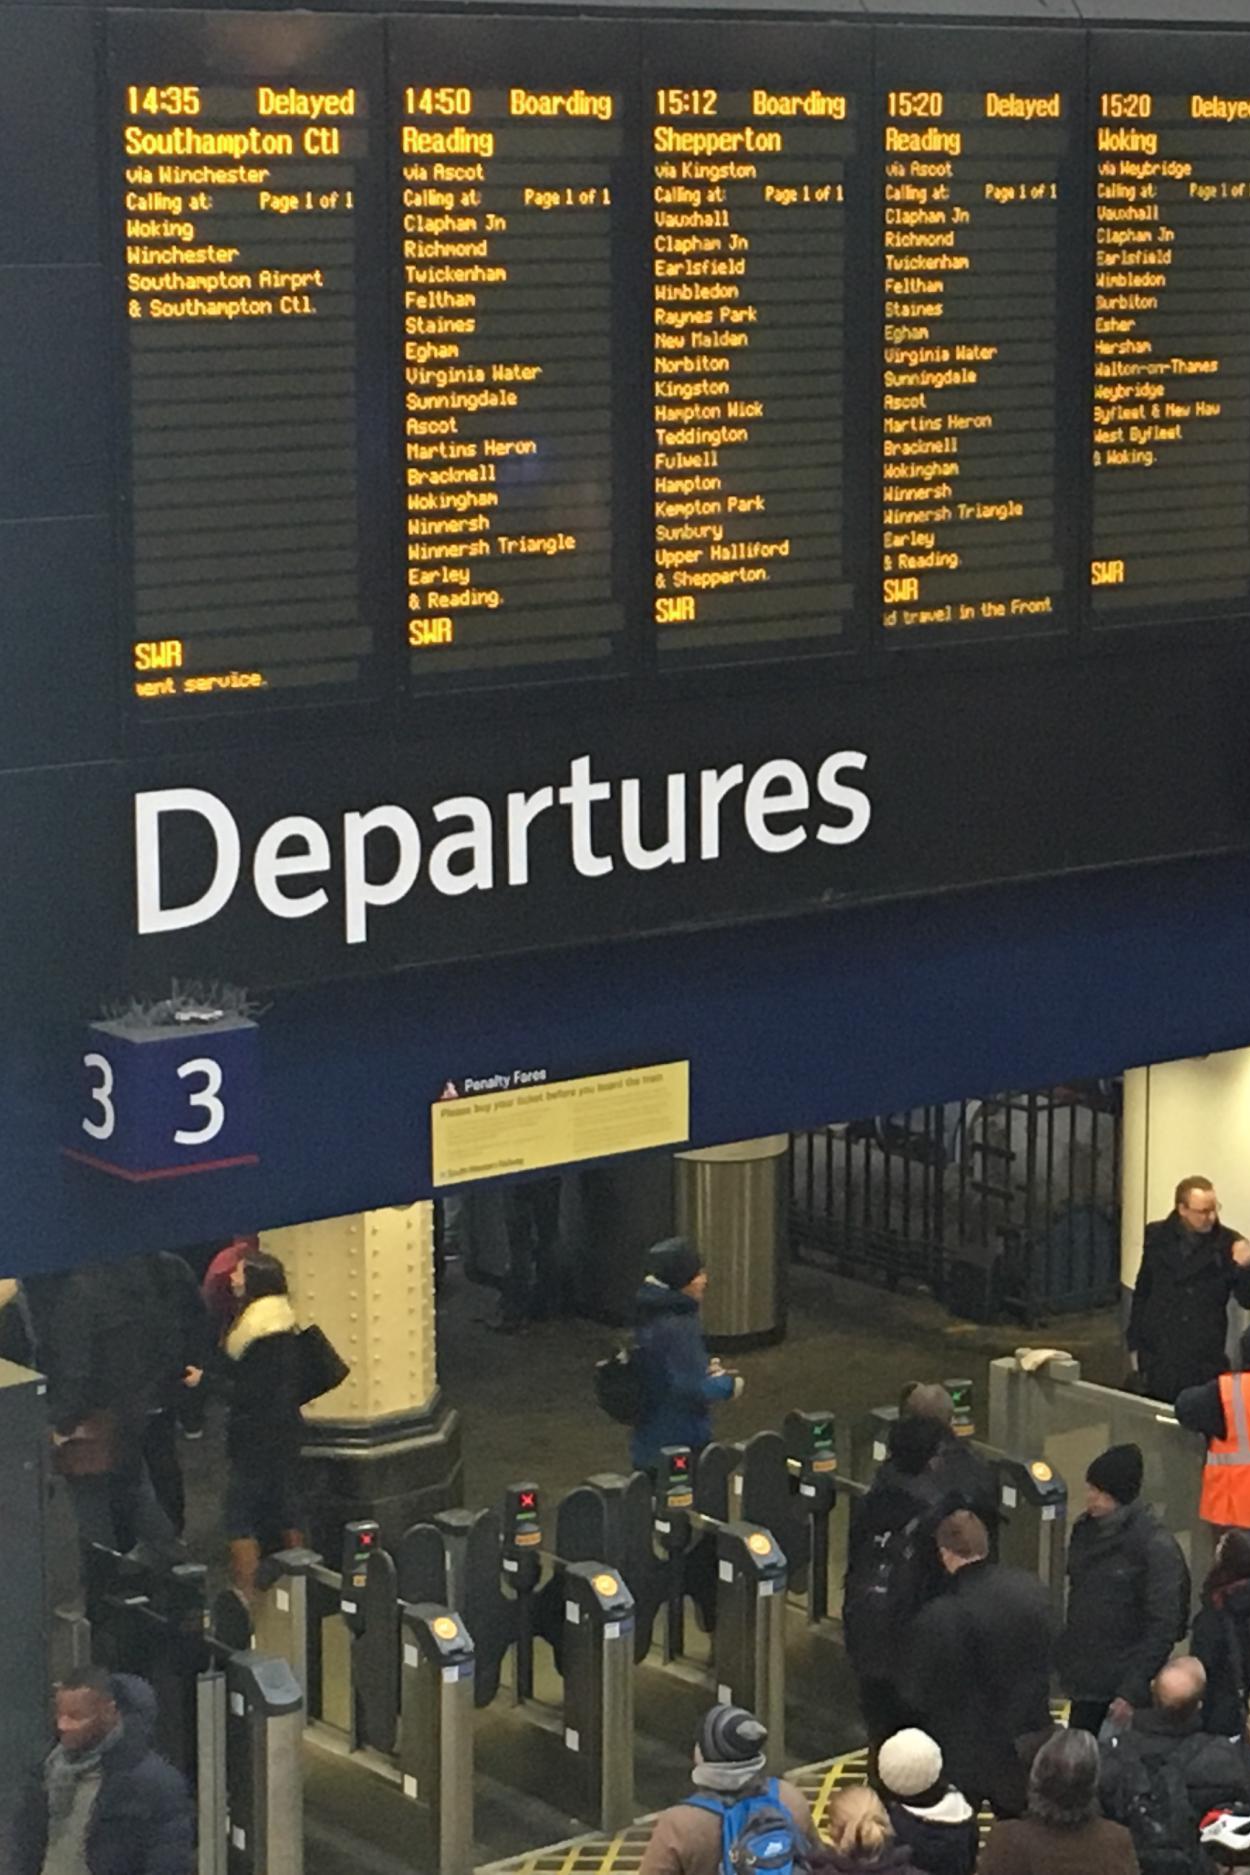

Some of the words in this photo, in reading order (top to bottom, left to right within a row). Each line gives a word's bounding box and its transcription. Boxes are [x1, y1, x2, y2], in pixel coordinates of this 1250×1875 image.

[128, 86, 201, 115] 14:35
[258, 87, 355, 120] Delayed
[405, 87, 472, 115] 14:50
[510, 88, 612, 120] Boarding
[657, 89, 717, 115] 15:12
[752, 90, 846, 120] Boarding
[888, 92, 943, 117] 15:20
[986, 92, 1060, 120] Delayed
[1101, 93, 1151, 118] 15:20
[124, 127, 293, 159] Southampton
[303, 127, 339, 155] Ctl
[402, 126, 494, 157] Reading
[654, 126, 782, 156] Shepperton
[886, 127, 961, 156] Reading
[1098, 128, 1157, 155] Woking
[125, 165, 154, 185] via
[158, 165, 270, 184] Winchester
[403, 163, 428, 181] via
[432, 163, 485, 181] Ascot
[654, 162, 678, 179] via
[681, 161, 757, 183] Kingston
[910, 160, 953, 177] Ascot
[126, 192, 183, 215] Calling
[259, 191, 300, 214] Page
[305, 192, 313, 210] 1
[319, 191, 339, 209] of
[345, 191, 353, 209] 1
[403, 188, 455, 211] Calling
[524, 188, 561, 210] Page
[565, 188, 574, 205] 1
[578, 188, 597, 205] of
[602, 188, 611, 205] 1
[654, 186, 702, 207] Calling
[765, 185, 798, 205] Page
[803, 185, 811, 202] 1
[814, 185, 831, 202] of
[836, 184, 844, 202] 1
[404, 214, 477, 236] Clapham
[485, 214, 506, 231] Jn
[654, 209, 729, 228] Vauxhall
[126, 219, 195, 242] Woking
[126, 245, 240, 265] Winchester
[404, 239, 487, 258] Richmond
[654, 234, 721, 255] Clapham
[728, 234, 748, 251] Jn
[654, 258, 745, 277] Earlsfield
[886, 254, 969, 271] Twickenham
[128, 271, 252, 293] Southampton
[258, 269, 323, 292] Airprt
[405, 264, 507, 284] Twickenham
[654, 282, 739, 301] Wimbledon
[885, 277, 944, 294] Feltham
[128, 299, 142, 318] &
[149, 297, 273, 319] Southampton
[405, 290, 476, 309] Feltham
[885, 301, 943, 318] Staines
[405, 316, 476, 335] Staines
[654, 308, 713, 328] Raynes
[719, 306, 757, 323] Park
[654, 332, 686, 349] New
[691, 330, 748, 348] Malden
[405, 341, 459, 363] Egham
[884, 346, 950, 366] Virginia
[955, 345, 998, 361] Water
[654, 355, 730, 373] Norbiton
[405, 366, 485, 388] Virginia
[491, 364, 542, 381] Water
[884, 368, 977, 388] Sunningdale
[406, 389, 518, 411] Sunningdale
[655, 379, 730, 400] Kingston
[655, 403, 721, 424] Hampton
[727, 401, 763, 418] Wick
[406, 416, 458, 436] Ascot
[655, 426, 748, 447] Teddington
[406, 441, 477, 460] Martins
[484, 439, 537, 456] Heron
[655, 450, 718, 470] Fulwell
[407, 464, 496, 486] Bracknell
[655, 475, 721, 495] Hampton
[408, 490, 498, 512] Wokingham
[655, 499, 722, 519] Kempton
[727, 495, 765, 512] Park
[408, 514, 490, 535] Winnersh
[656, 523, 723, 542] Sunbury
[408, 538, 490, 560] Winnersh
[497, 533, 576, 555] Triangle
[655, 548, 704, 569] Upper
[710, 540, 789, 561] Halliford
[408, 566, 470, 586] Earley
[1091, 560, 1124, 585] SWR
[883, 577, 919, 603] SWR
[408, 592, 421, 611] &
[655, 595, 695, 623] SWR
[980, 602, 1006, 618] the
[409, 617, 453, 646] SWR
[134, 640, 183, 670] SWR
[134, 748, 872, 944] Departures
[465, 1075, 510, 1092] Penalty
[514, 1068, 546, 1084] Fares
[82, 1053, 116, 1140] 3
[174, 1057, 225, 1145] 3
